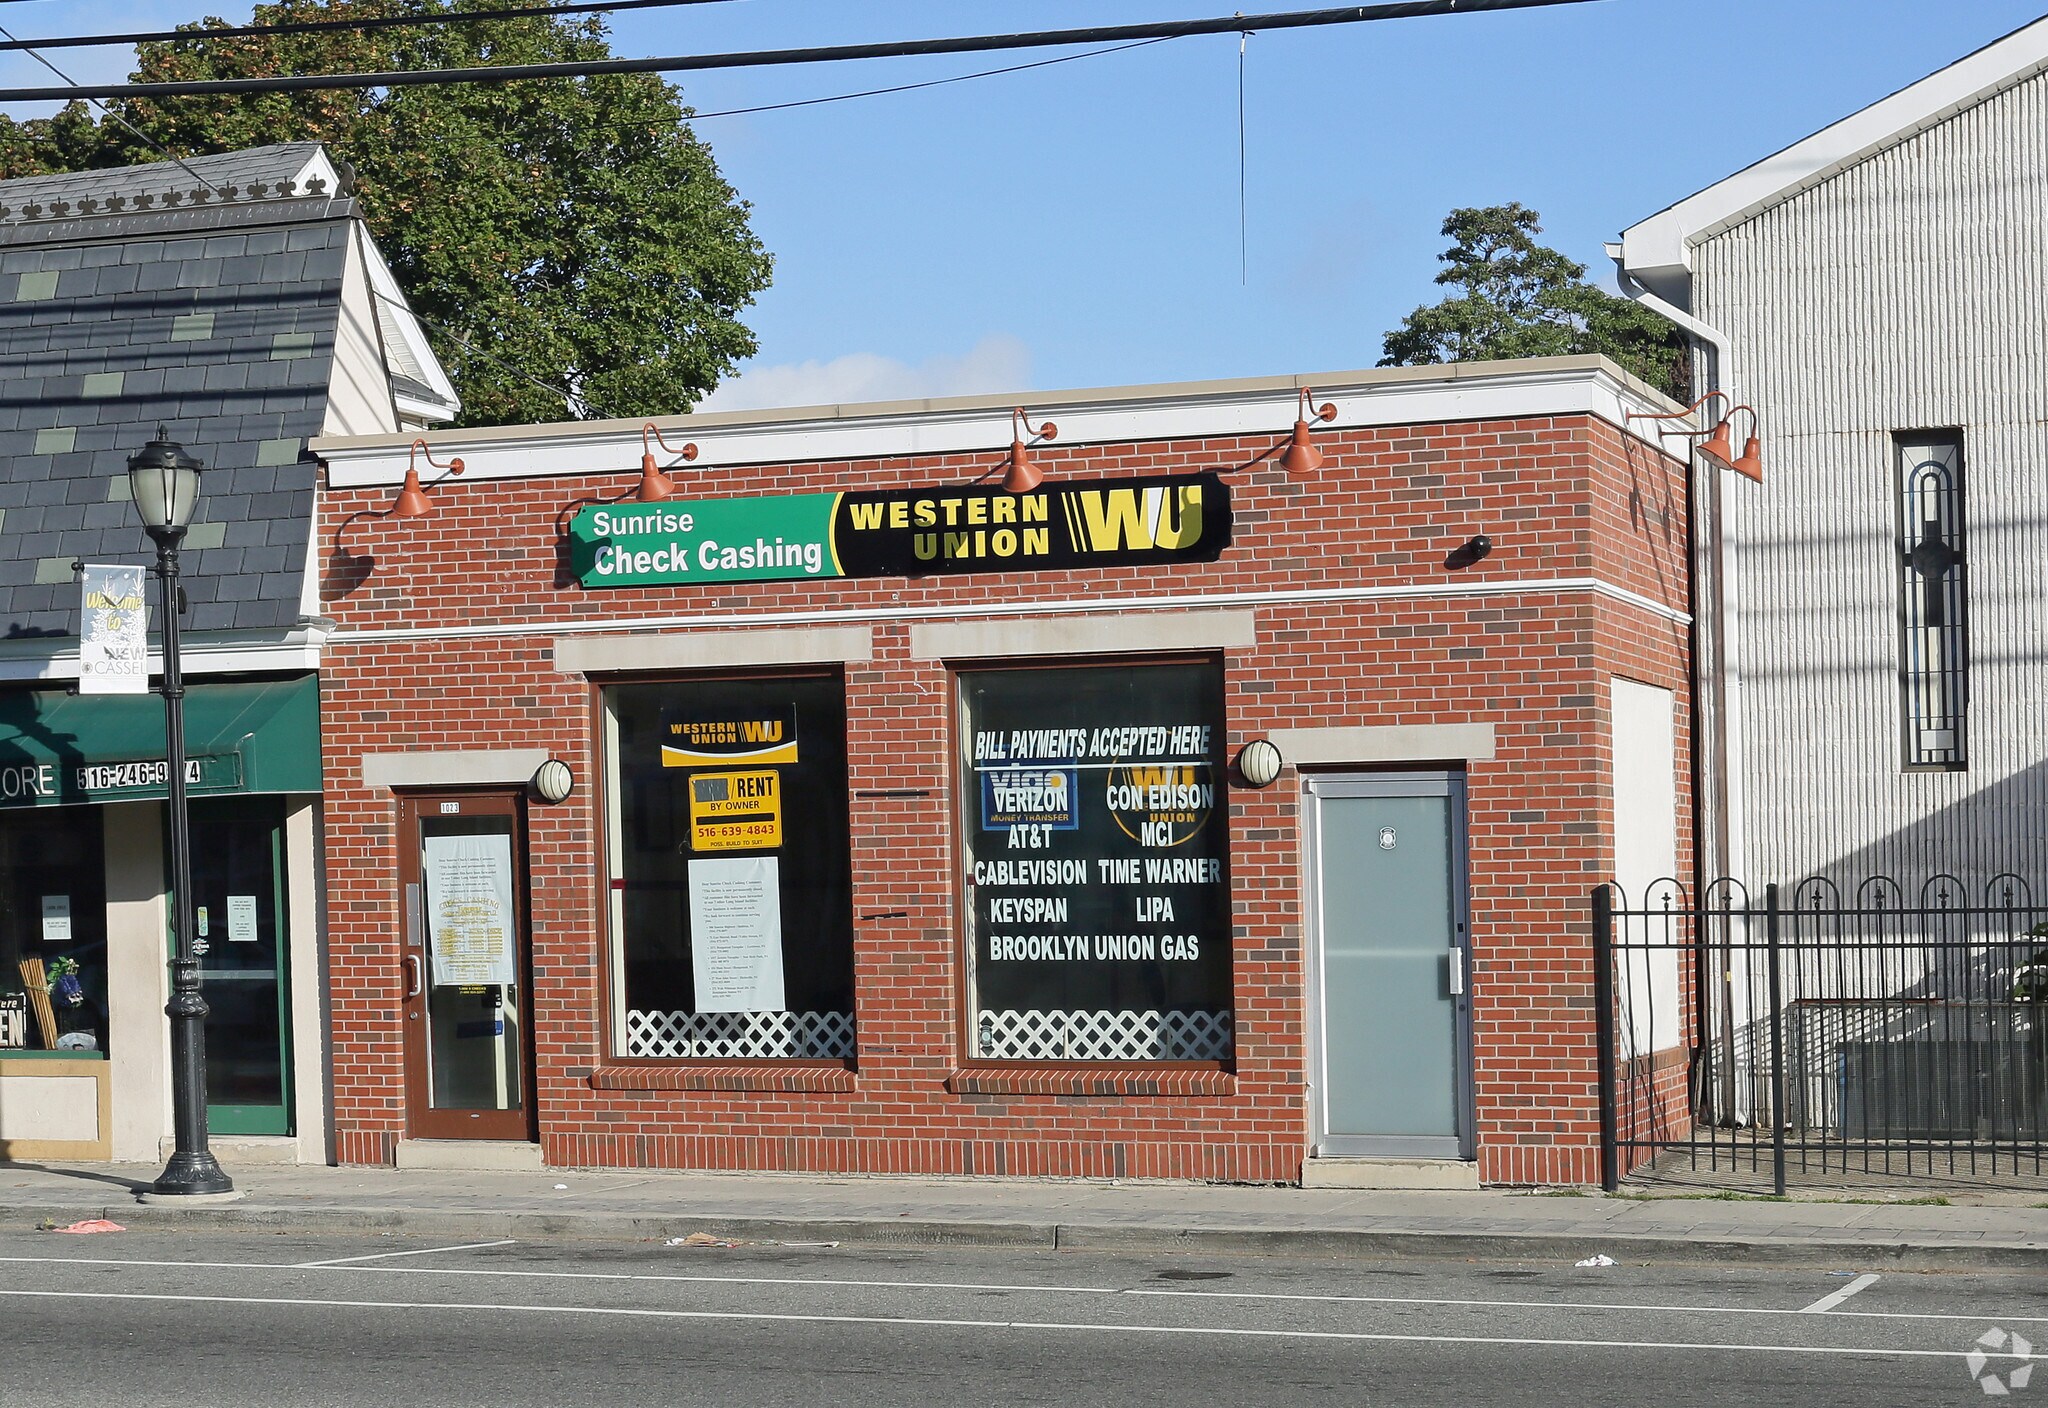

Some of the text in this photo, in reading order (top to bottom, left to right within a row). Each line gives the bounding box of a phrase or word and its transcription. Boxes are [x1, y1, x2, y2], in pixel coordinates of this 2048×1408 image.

[592, 508, 694, 536] Sunrise
[849, 484, 1203, 551] WESTERN WU
[594, 536, 822, 576] Check Cashing
[914, 527, 1049, 561] UNION
[86, 591, 142, 610] Welcome
[106, 613, 121, 631] to
[670, 720, 783, 743] WESTERN WU
[691, 733, 736, 744] UNION
[974, 725, 1211, 760] BILL PAYMENTS ACCEPTED HERE
[442, 803, 459, 813] 1023
[710, 800, 760, 811] BY OWNER
[993, 783, 1214, 813] VERIZON CON EDISON
[698, 824, 775, 838] 516-639-4843
[991, 813, 1069, 822] MONEY TRANSFER
[1149, 812, 1196, 823] UNION
[1007, 821, 1173, 849] AT&T MCI
[974, 858, 1221, 886] CABLEVISION TIME WARNER
[990, 896, 1175, 923] KEYSPAN LIPA
[990, 934, 1200, 961] BROOKLYN UNION GAS
